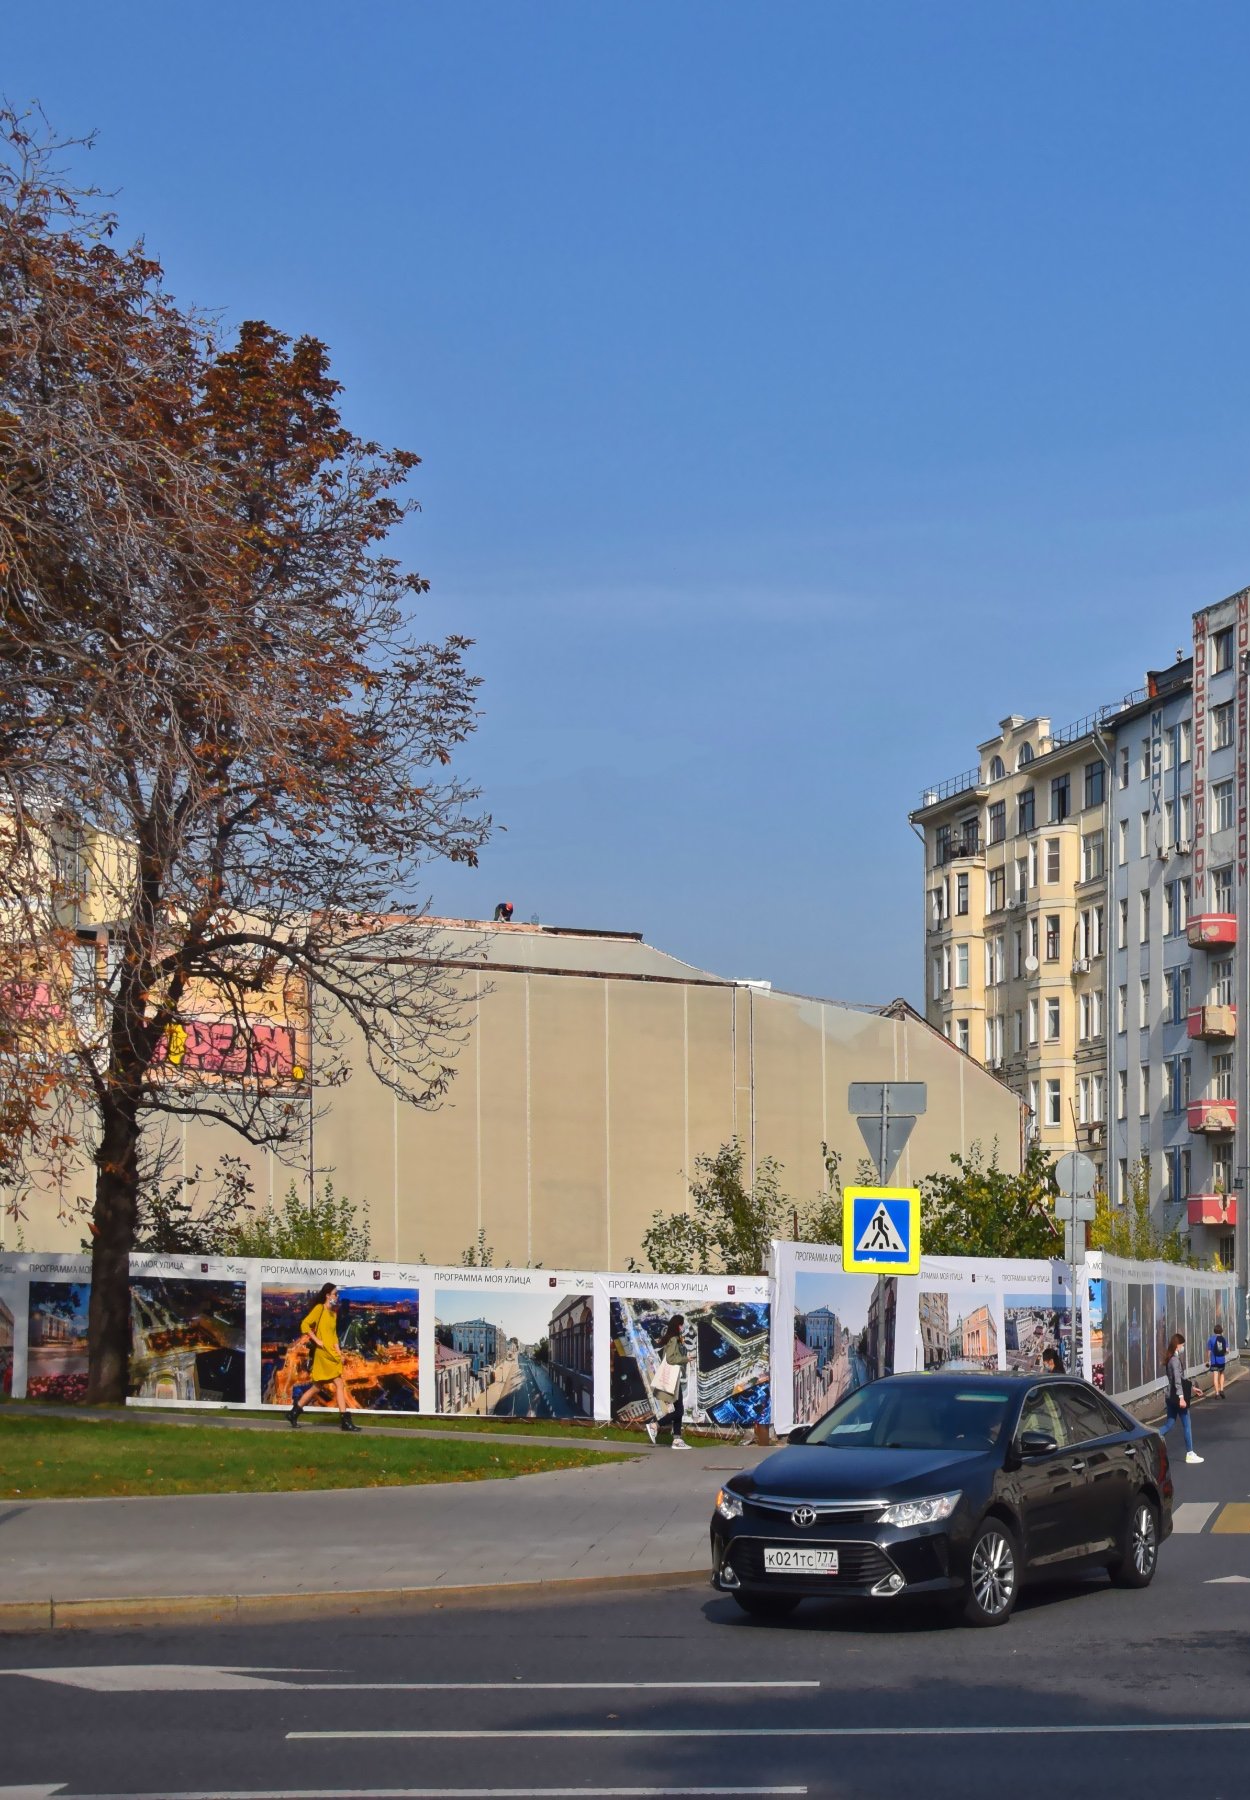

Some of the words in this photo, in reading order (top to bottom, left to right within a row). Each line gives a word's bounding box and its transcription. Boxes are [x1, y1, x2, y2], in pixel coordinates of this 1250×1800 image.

[1151, 711, 1161, 815] МСНХ
[1195, 616, 1205, 899] МОССЕЛЬПРОМ
[795, 1251, 828, 1262] ПРОГРАММА
[828, 1253, 841, 1263] МОЯ
[29, 1264, 77, 1273] ПРОГРАММА
[141, 1260, 157, 1268] МОЯ
[160, 1261, 184, 1270] УЛИЦА
[260, 1265, 308, 1275] ПРОГРАММА
[309, 1267, 327, 1276] МОЯ
[329, 1268, 355, 1277] УЛИЦА
[434, 1272, 482, 1282] ПРОГРАММА
[484, 1275, 502, 1283] МОЯ
[504, 1275, 531, 1285] УЛИЦА
[608, 1280, 659, 1290] ПРОГРАММА
[660, 1282, 679, 1290] МОЯ
[681, 1283, 708, 1292] УЛИЦА
[768, 1552, 813, 1566] К021ТС
[817, 1552, 834, 1563] 777
